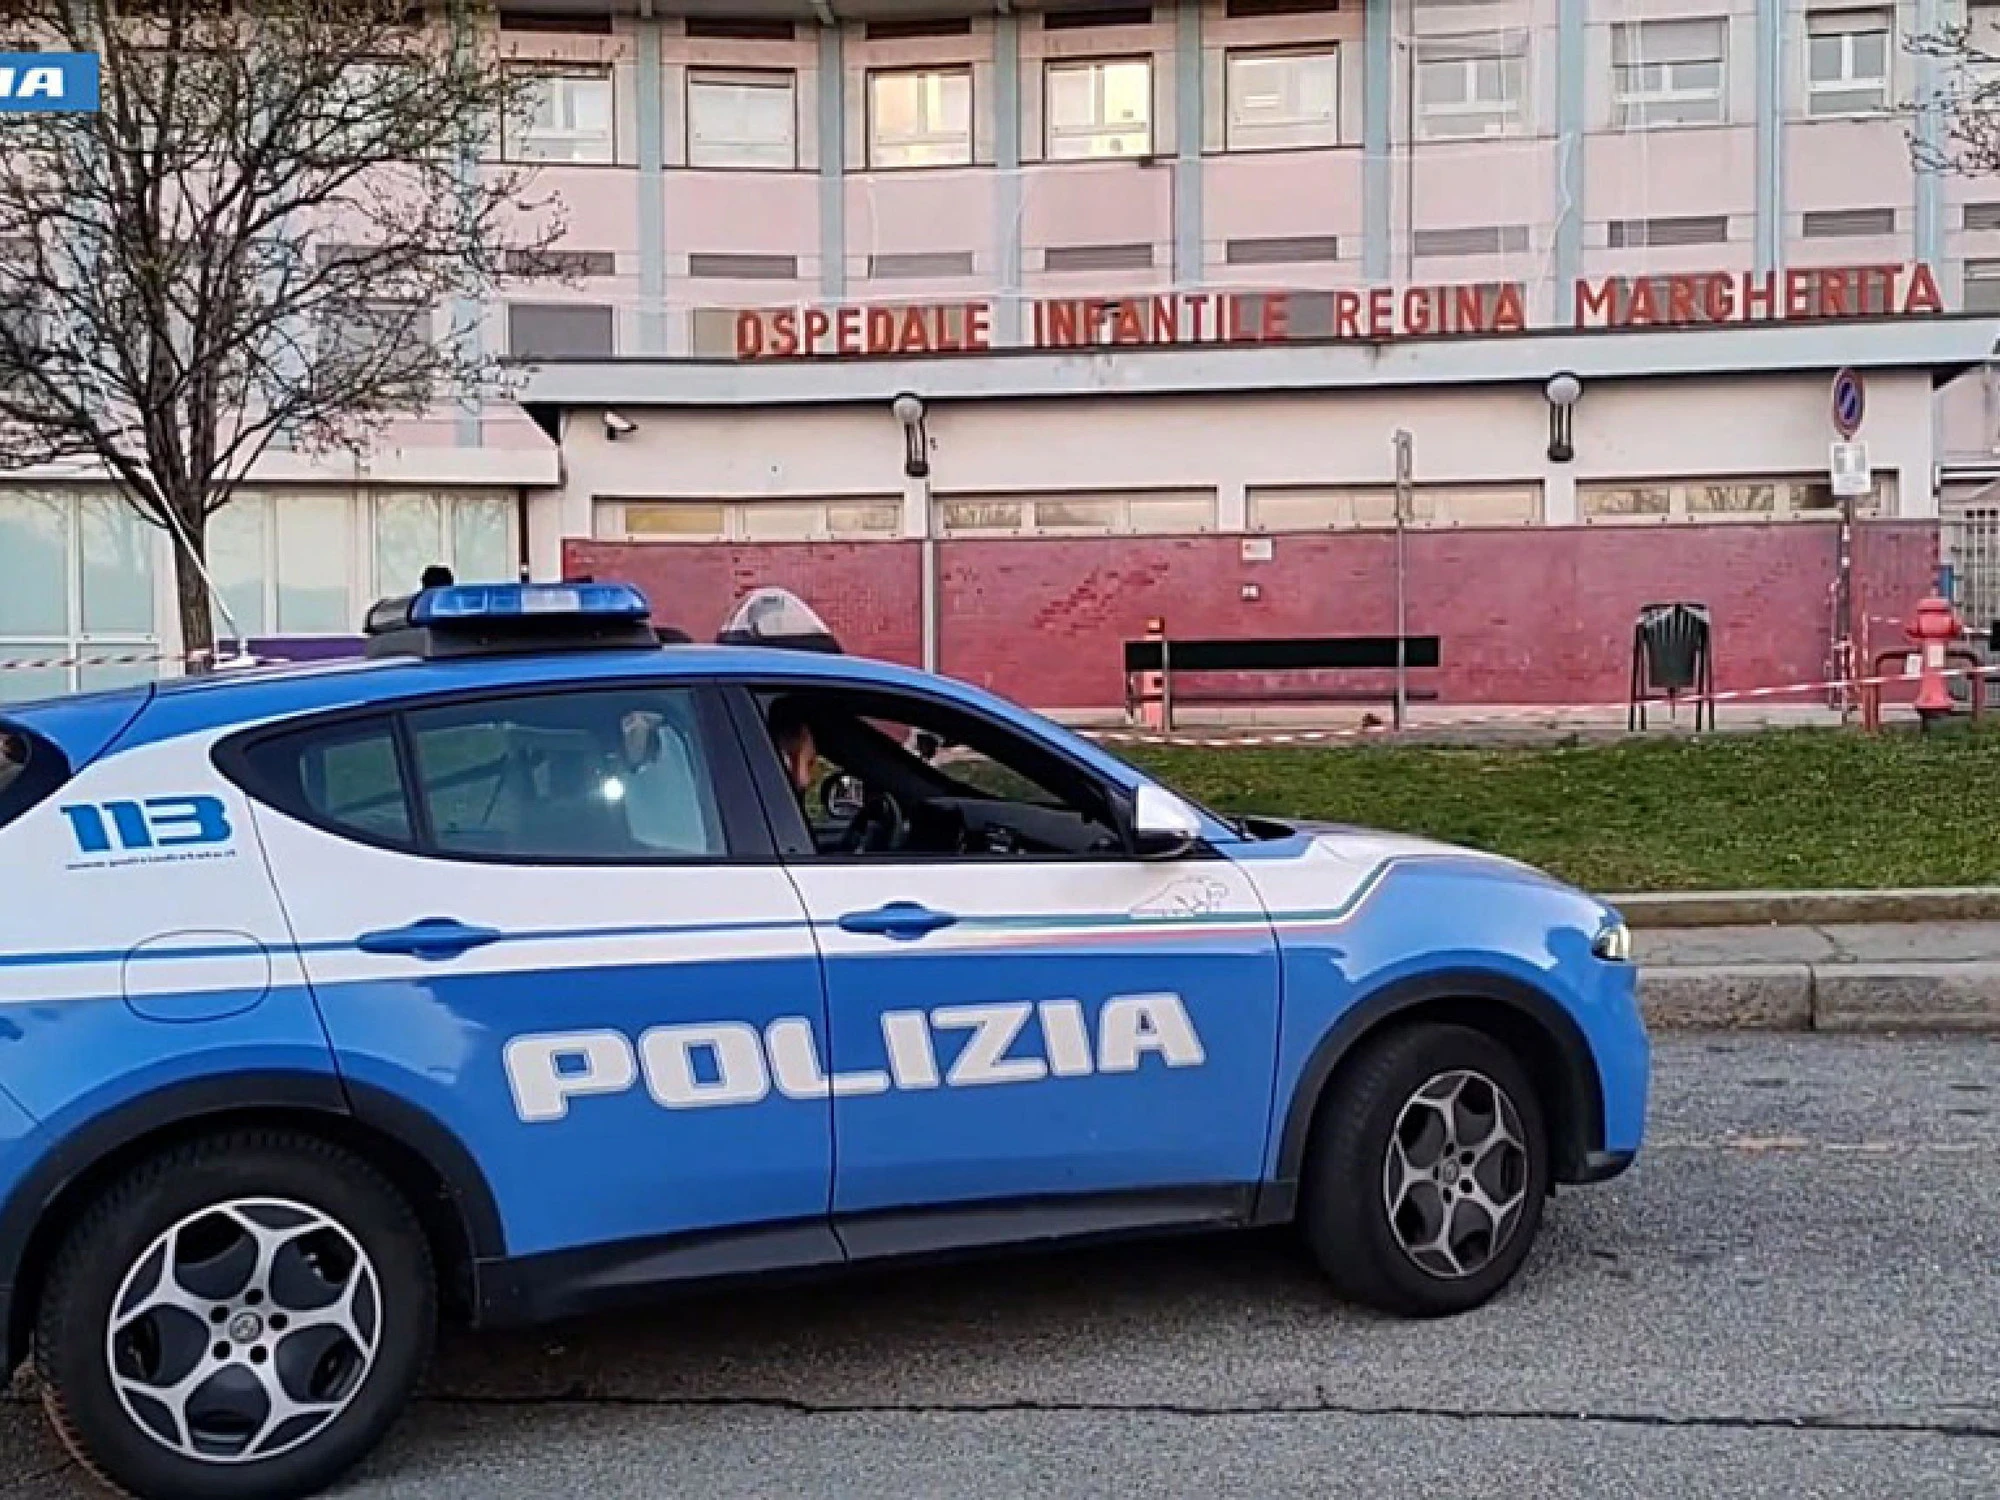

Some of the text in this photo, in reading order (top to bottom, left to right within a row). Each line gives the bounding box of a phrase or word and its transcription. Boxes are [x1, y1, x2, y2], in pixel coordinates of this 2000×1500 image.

[736, 261, 1943, 358] OSPEDALE INFANTILE REGINA MARGHERITA
[60, 794, 232, 852] 113
[503, 991, 1206, 1122] POLIZIA
